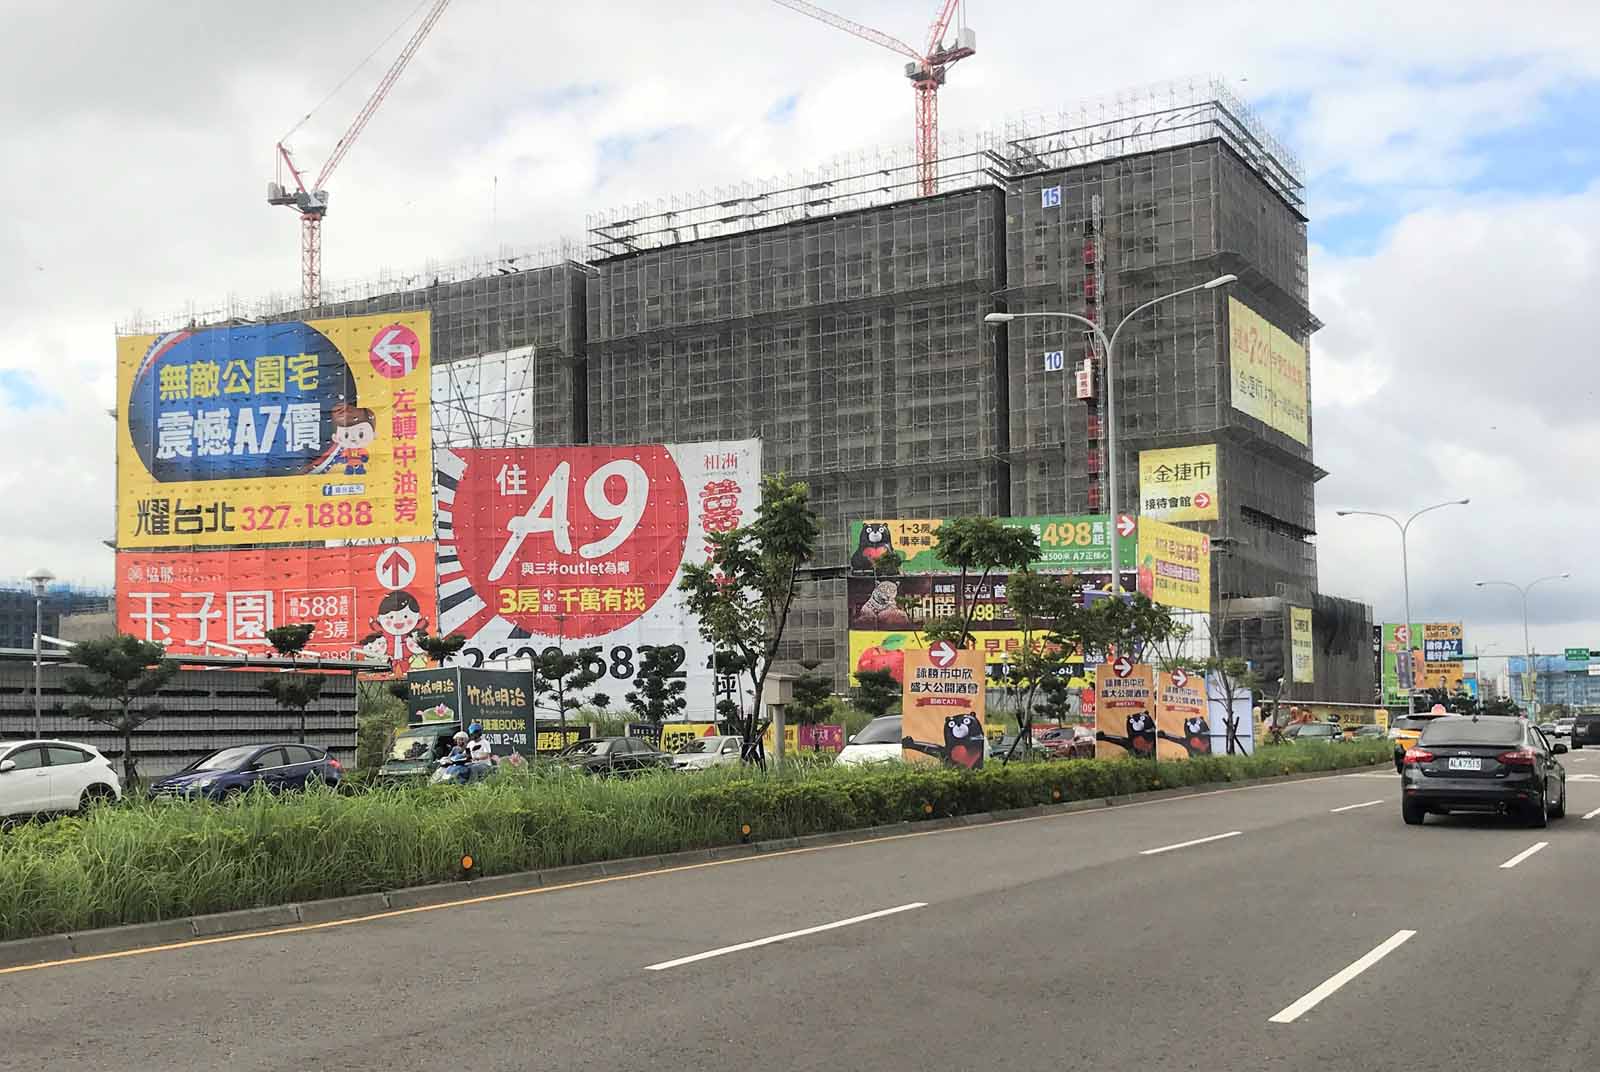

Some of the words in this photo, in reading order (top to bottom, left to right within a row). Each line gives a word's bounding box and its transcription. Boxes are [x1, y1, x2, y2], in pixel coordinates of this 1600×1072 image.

[1043, 191, 1059, 204] 15
[1046, 353, 1062, 369] 10
[159, 353, 320, 399] 無敵公園宅
[155, 402, 321, 459] 震撼A7價
[391, 390, 418, 524] 左轉中油旁
[496, 463, 528, 496] 住
[1153, 461, 1211, 484] 金捷市
[1145, 496, 1192, 511] 接待會館
[133, 498, 236, 537] 耀台北
[240, 501, 373, 531] 327-1888
[487, 458, 650, 582] A9
[898, 523, 931, 534] 1-3房
[1042, 521, 1092, 546] 498
[299, 595, 338, 617] 588
[499, 588, 540, 614] 3房
[558, 586, 646, 613] 千萬有找
[128, 590, 274, 646] 玉子園
[466, 685, 526, 707] 竹城明治
[911, 682, 978, 694] 盛大公開酒會
